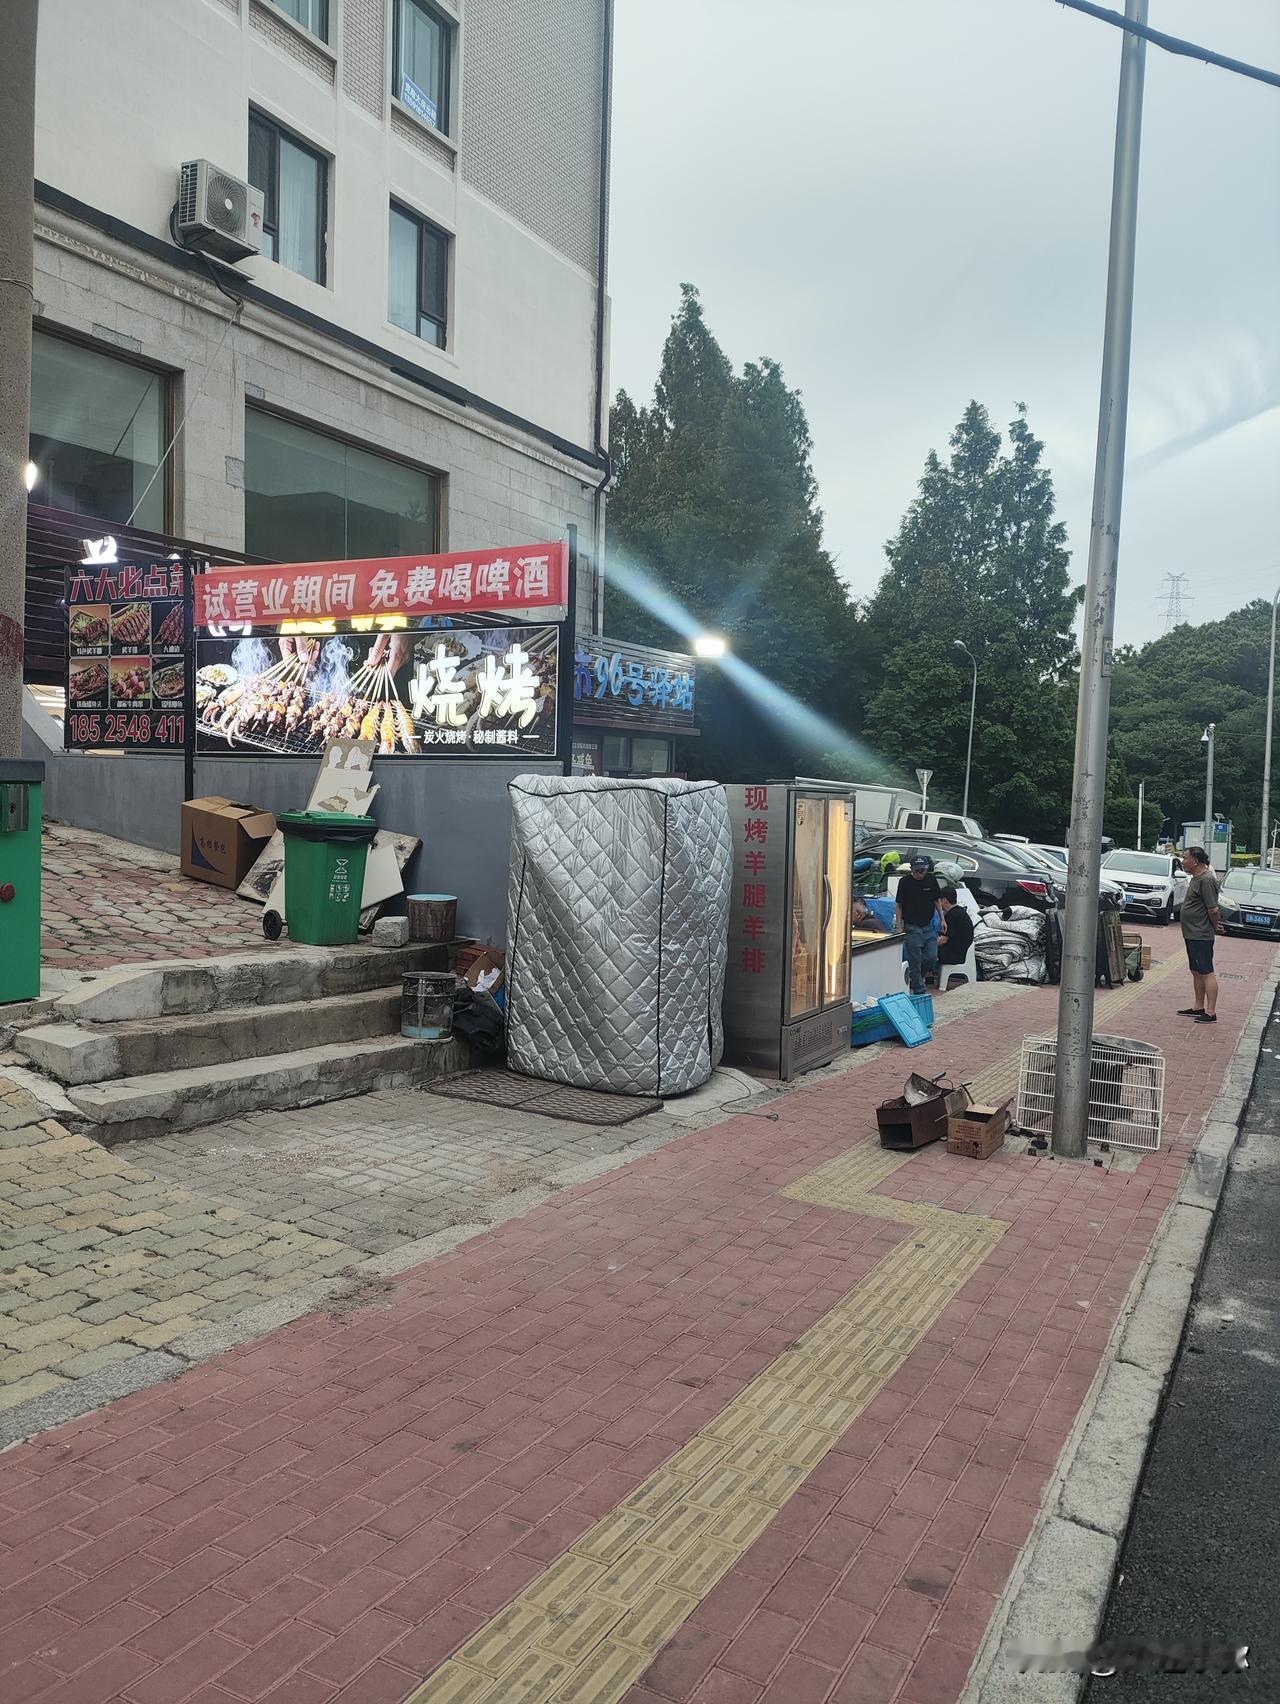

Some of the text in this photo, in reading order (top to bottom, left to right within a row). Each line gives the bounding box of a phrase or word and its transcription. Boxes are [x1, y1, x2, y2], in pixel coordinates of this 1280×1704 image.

[203, 555, 549, 620] 试营业期间 免费喝啤酒
[408, 643, 540, 729] 烧烤
[69, 714, 101, 743] 185
[104, 714, 151, 743] 2548
[742, 786, 769, 974] 现烤羊腿羊排
